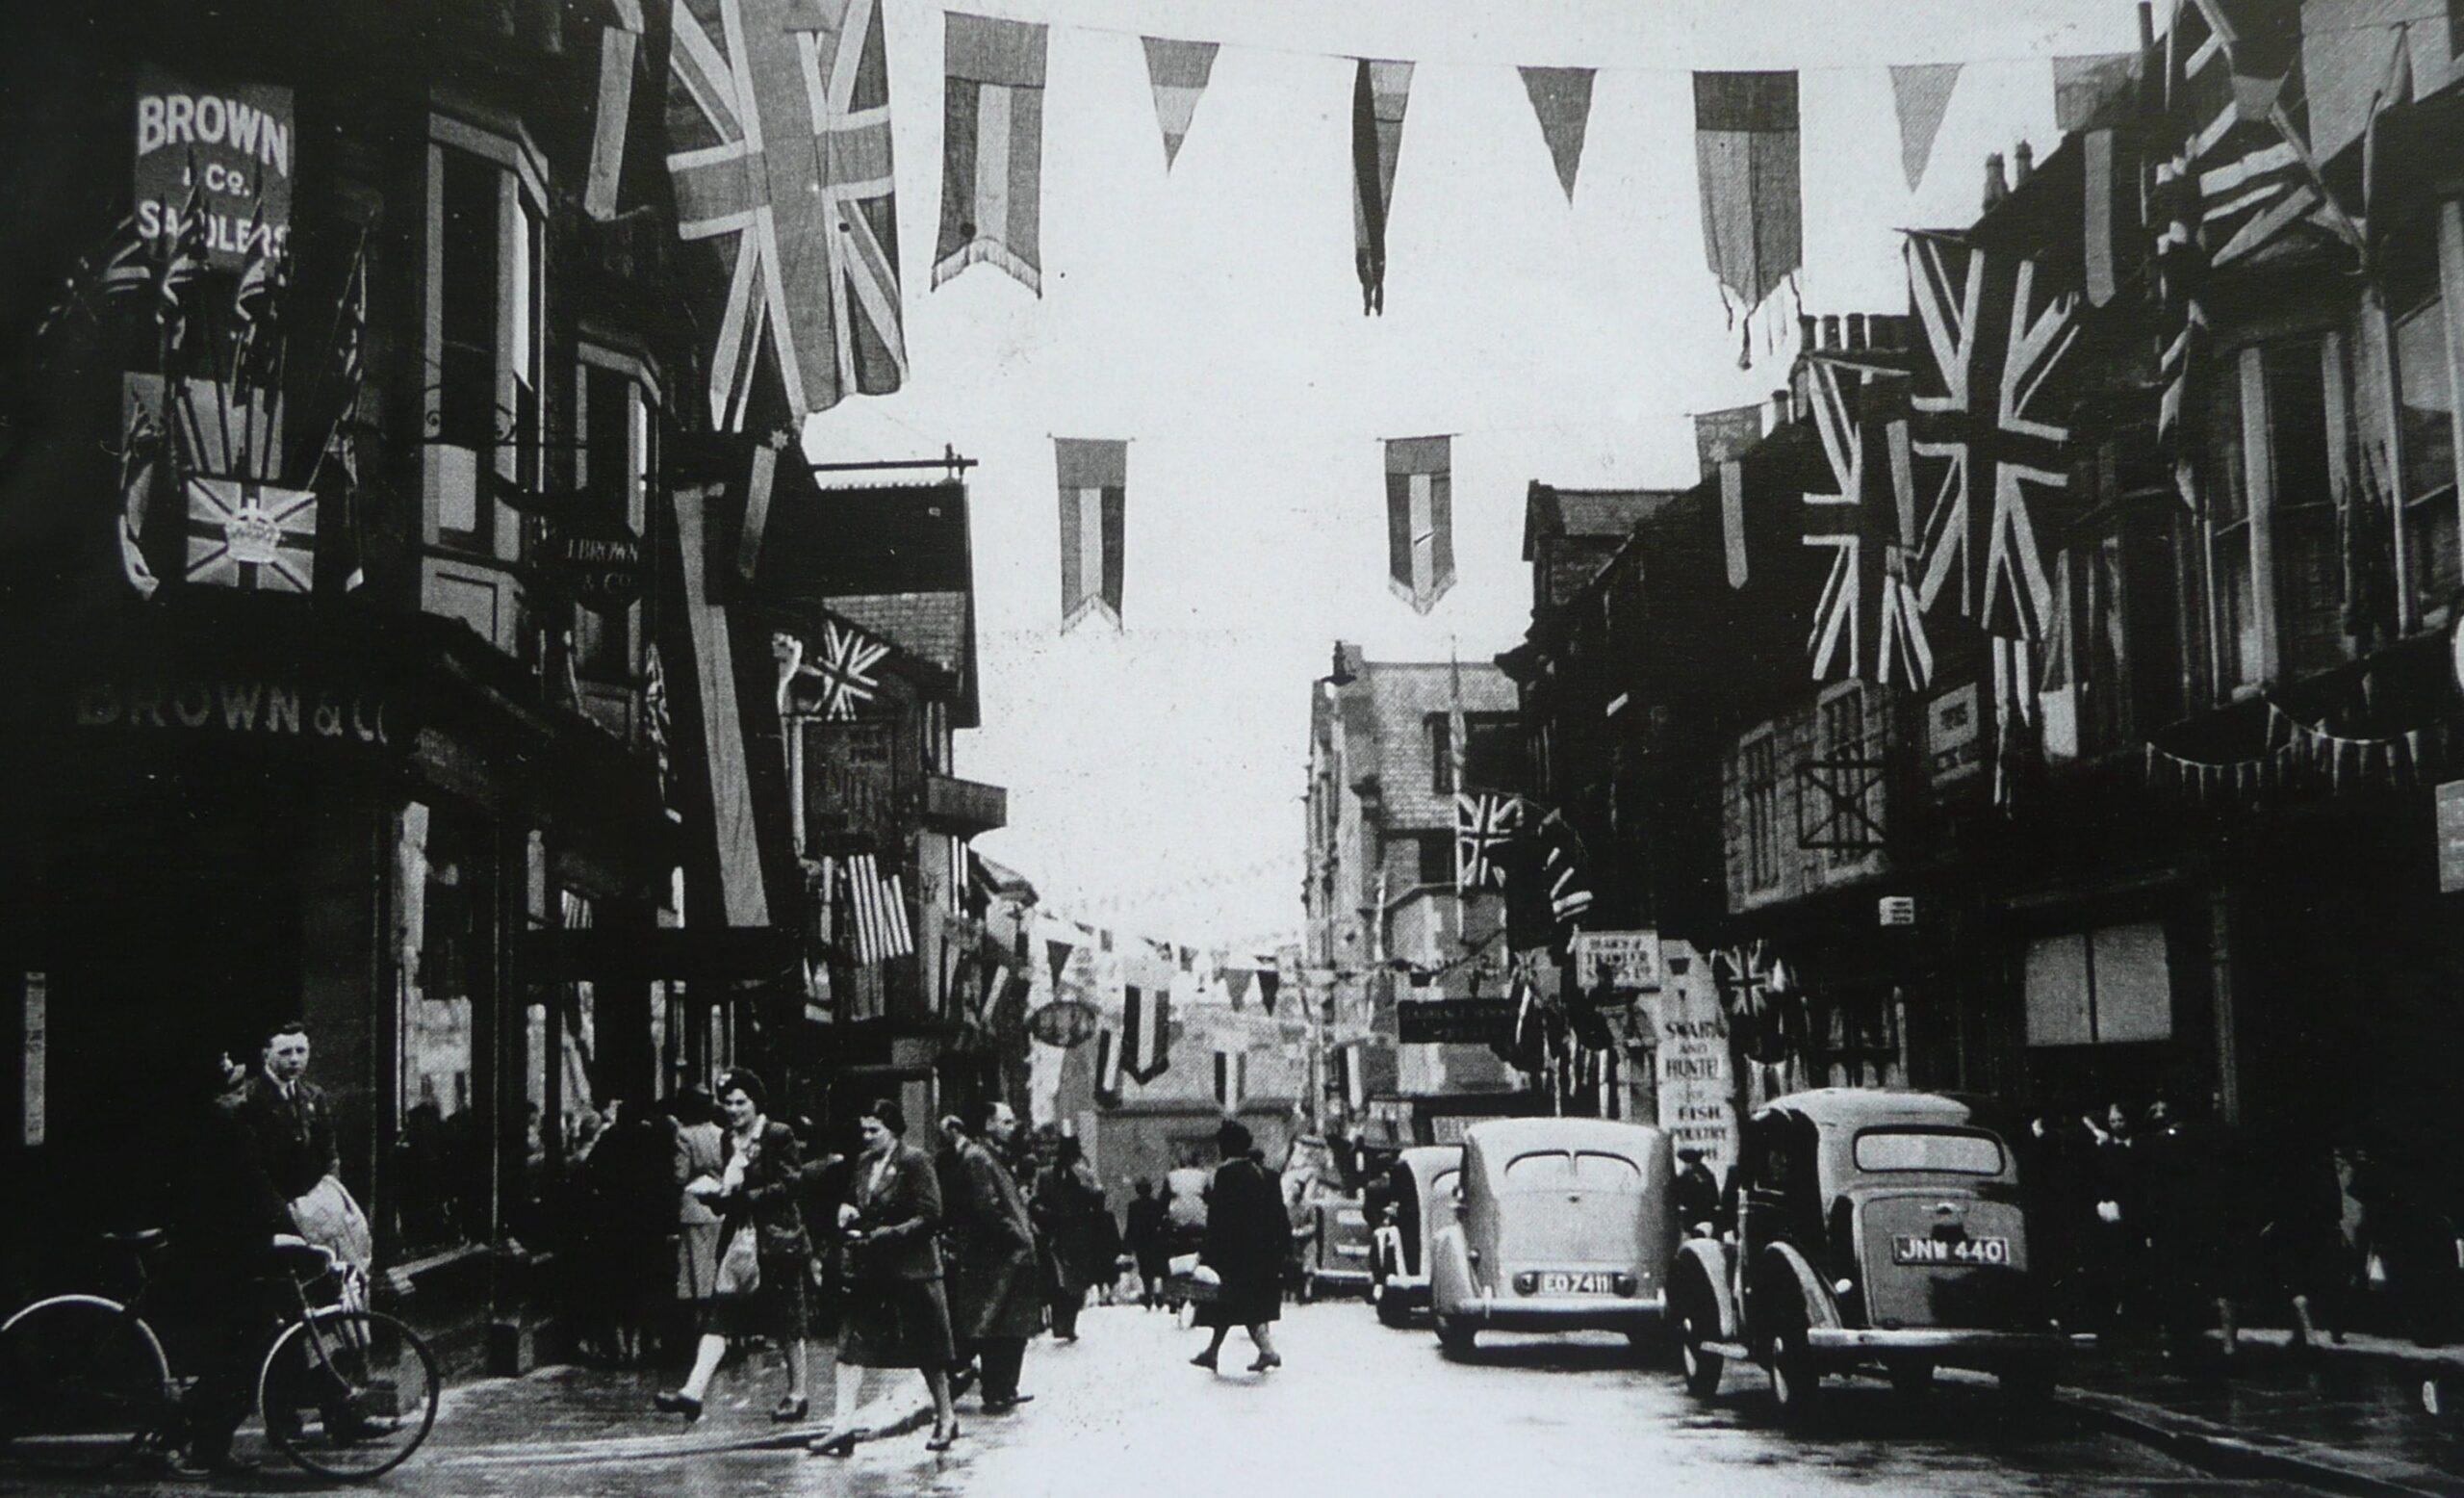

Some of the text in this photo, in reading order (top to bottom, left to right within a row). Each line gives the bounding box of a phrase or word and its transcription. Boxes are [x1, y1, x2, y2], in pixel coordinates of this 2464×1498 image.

[138, 93, 288, 178] BROWN
[1678, 1105, 1721, 1120] FISH
[1901, 1238, 2003, 1264] JNW 440
